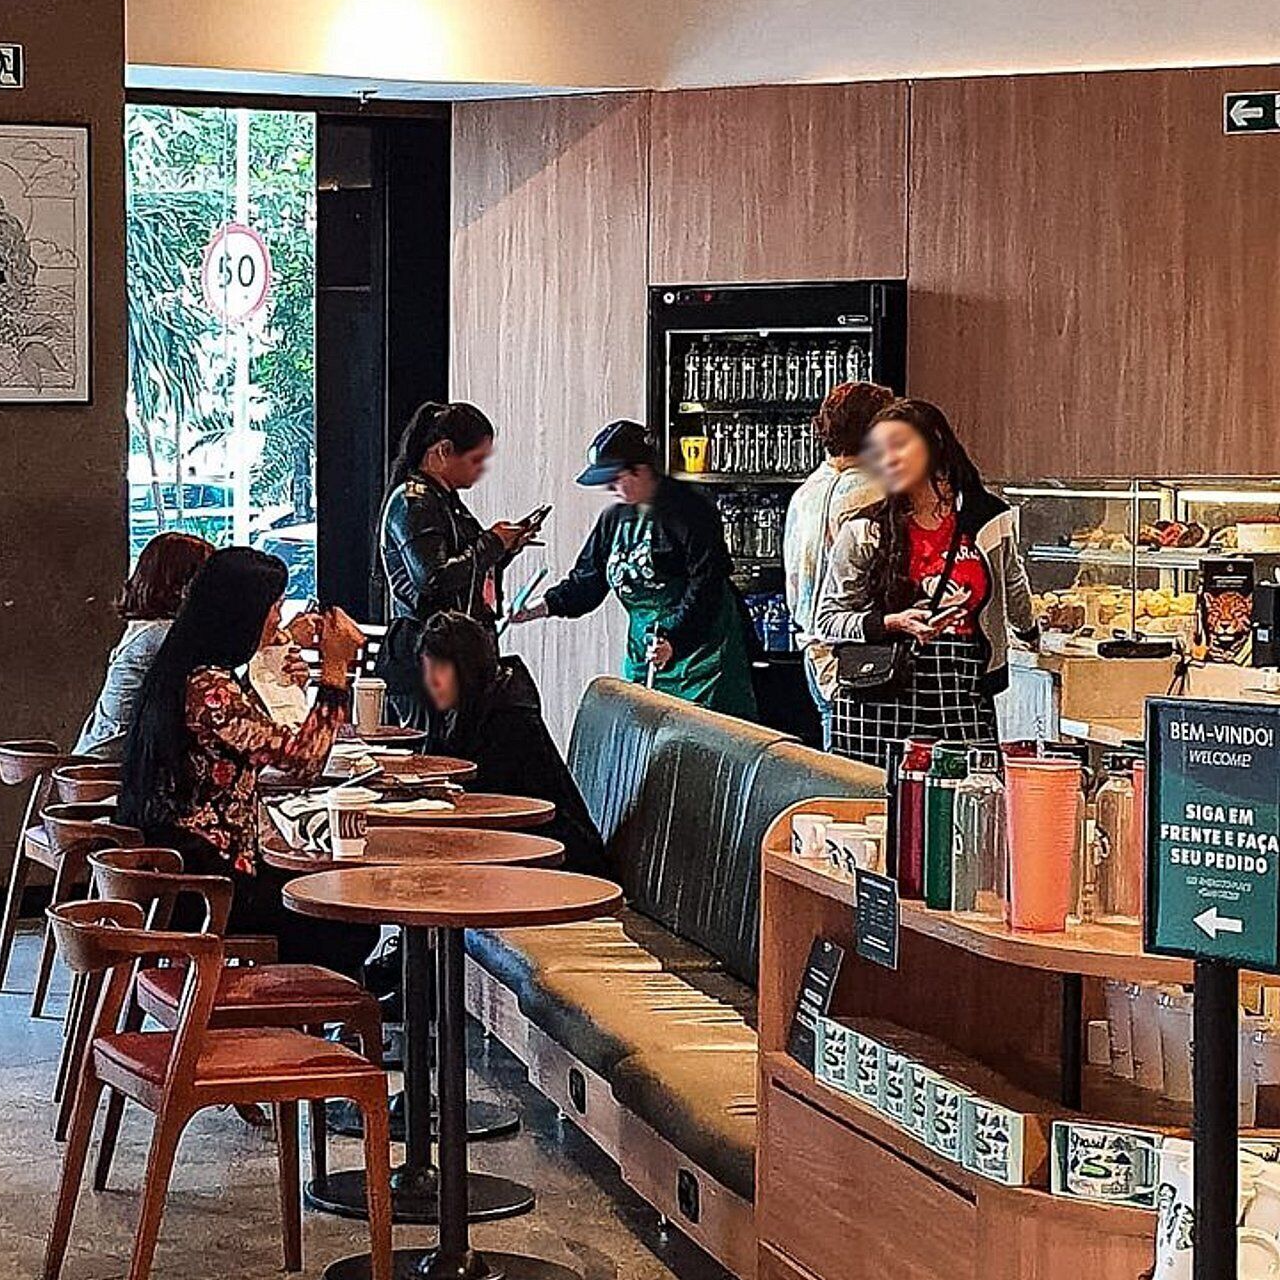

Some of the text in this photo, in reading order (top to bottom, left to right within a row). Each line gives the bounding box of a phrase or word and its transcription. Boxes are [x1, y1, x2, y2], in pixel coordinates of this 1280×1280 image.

[219, 254, 255, 288] 50
[1170, 721, 1274, 748] BEM-VINDO!
[1189, 749, 1252, 768] WELCOME
[1185, 803, 1253, 826] SIGA EM
[1160, 823, 1279, 855] FRENTE E FAÇA
[1170, 848, 1268, 873] SEU PEDIDO
